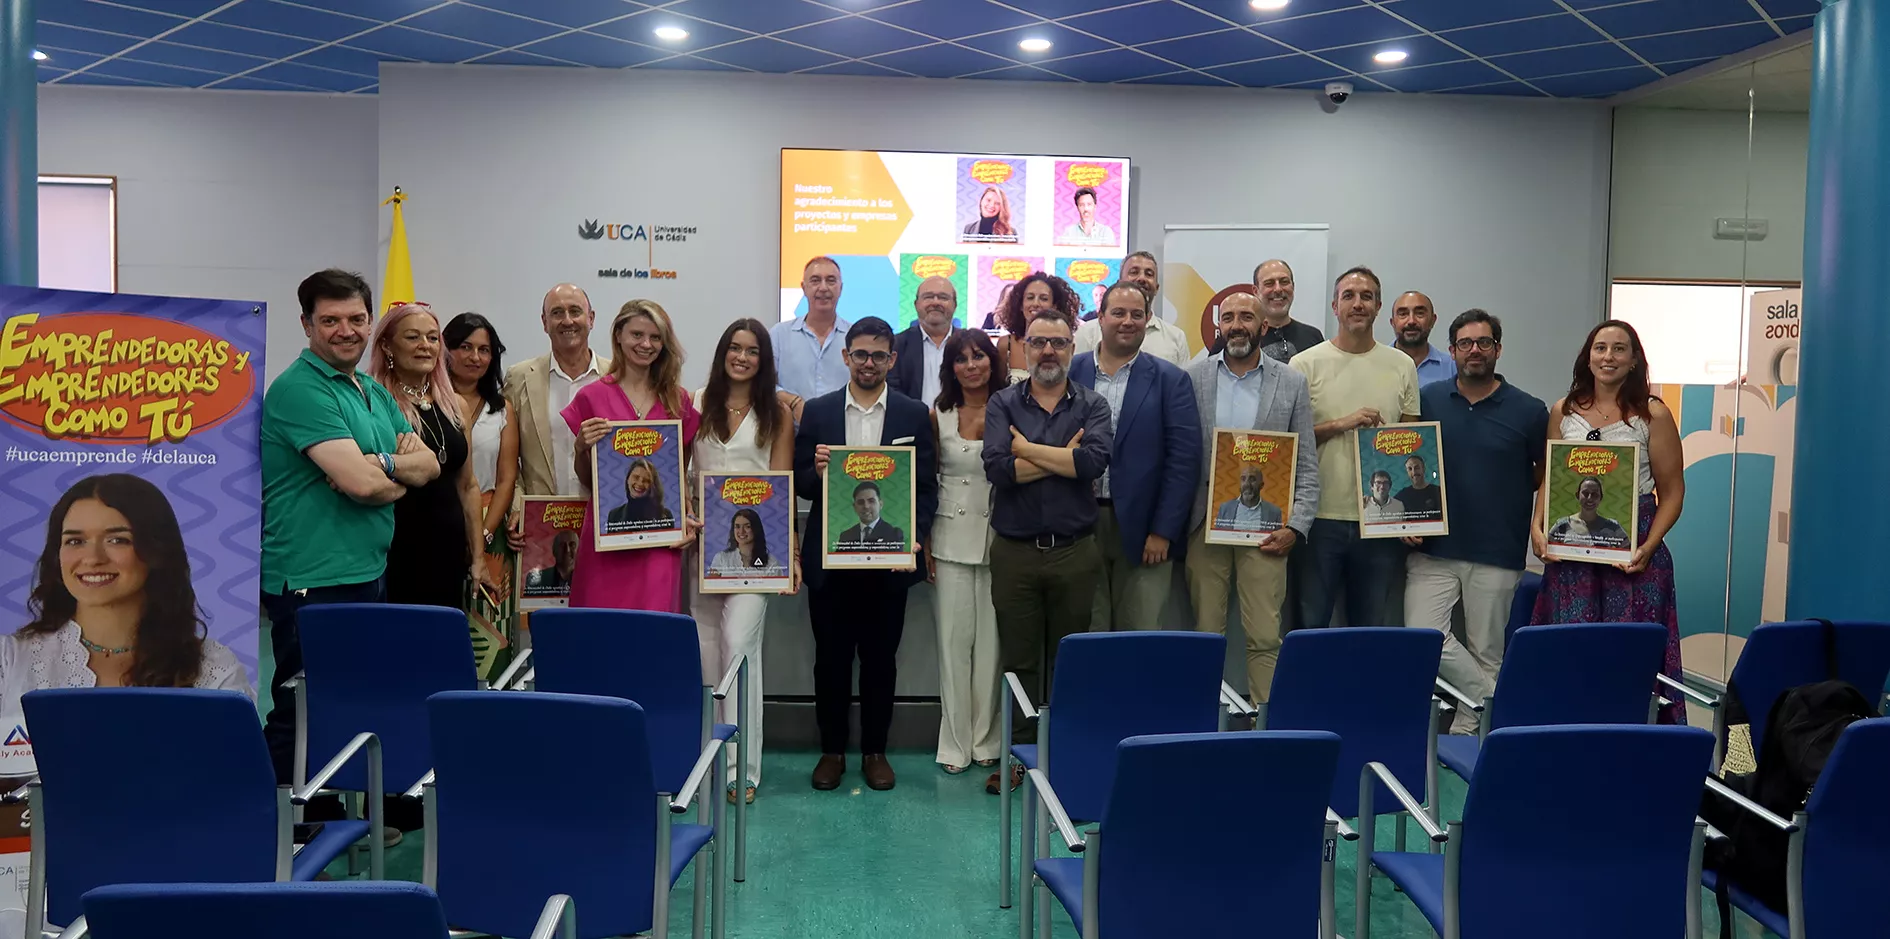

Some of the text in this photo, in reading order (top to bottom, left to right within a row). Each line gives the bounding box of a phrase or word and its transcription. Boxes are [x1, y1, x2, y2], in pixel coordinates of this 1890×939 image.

[794, 184, 833, 194] Nuestro
[794, 197, 893, 208] agradecimiento a los
[794, 210, 898, 222] proyectos y empresas
[606, 224, 647, 241] UCA
[654, 225, 697, 234] Universidad
[794, 222, 857, 234] participantes
[665, 233, 686, 242] Cádiz
[598, 268, 677, 279] sala de los libros
[1767, 300, 1798, 319] sala
[5, 446, 217, 466] #ucaemprende #delauca
